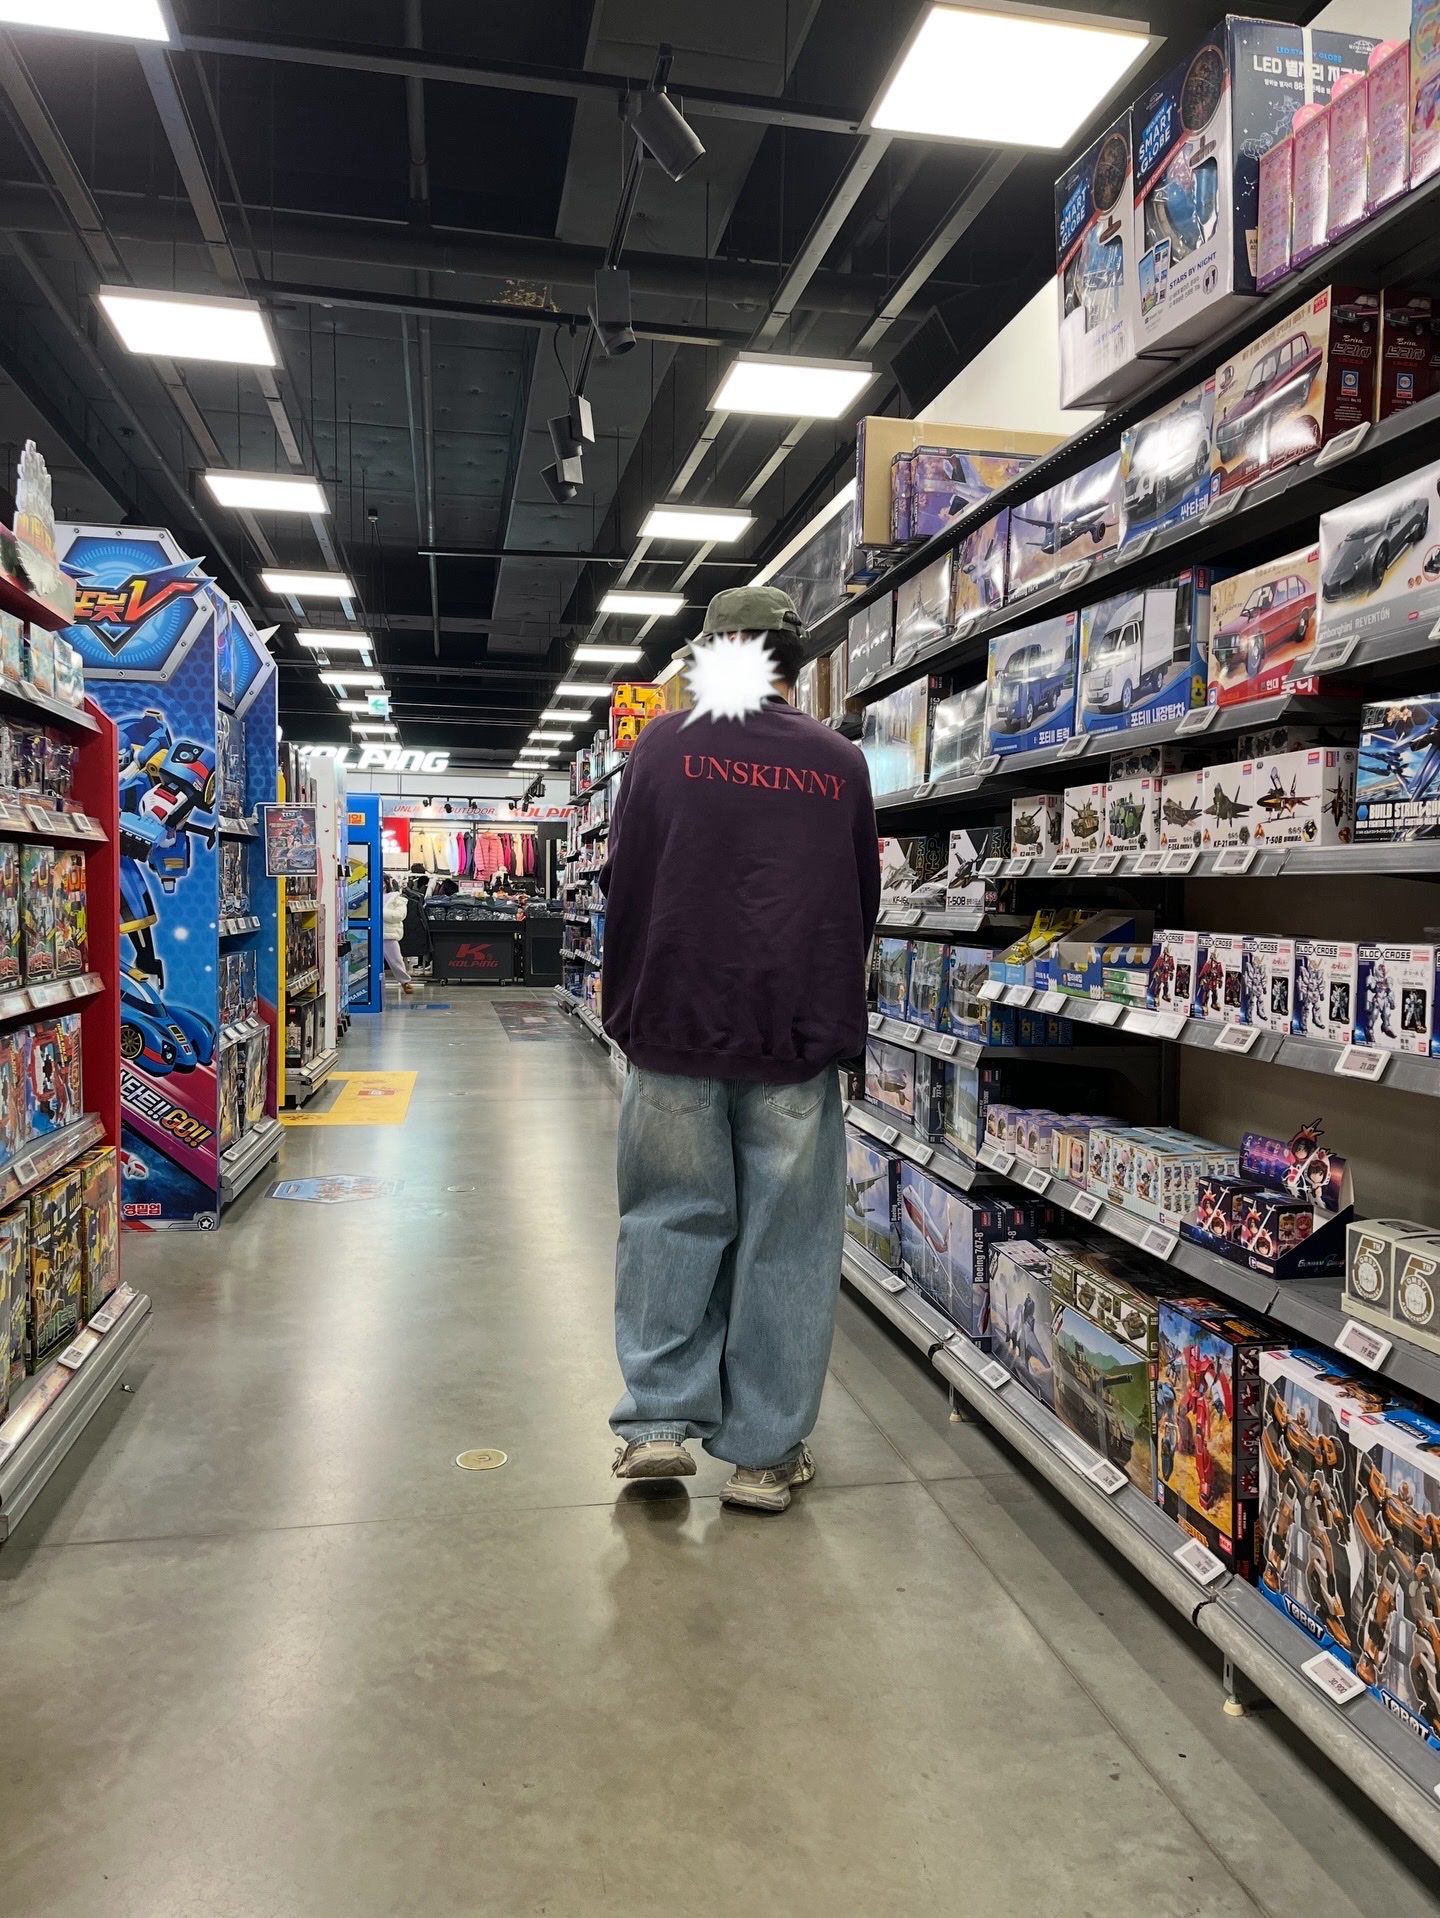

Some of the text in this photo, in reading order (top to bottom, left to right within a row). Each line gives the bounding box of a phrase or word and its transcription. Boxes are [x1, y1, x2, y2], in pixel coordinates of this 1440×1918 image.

[1253, 54, 1282, 74] LED
[1138, 105, 1173, 160] SMART
[1140, 129, 1172, 174] GLOBE
[1060, 187, 1087, 235] SMART
[1061, 208, 1087, 248] GLOBE
[1169, 271, 1188, 290] STARS
[1196, 250, 1217, 270] NIGHT
[1152, 701, 1186, 723] 내장탑차
[683, 754, 847, 801] UNSKINNY
[1369, 802, 1393, 819] BUILD
[1394, 801, 1424, 818] STRIKE
[1259, 943, 1279, 953] CROSS
[1315, 946, 1338, 956] CROSS
[1359, 949, 1411, 960] BLOC CROSS
[448, 960, 499, 969] KOLPING
[160, 1107, 213, 1148] GO!!
[974, 1254, 985, 1283] Boeing
